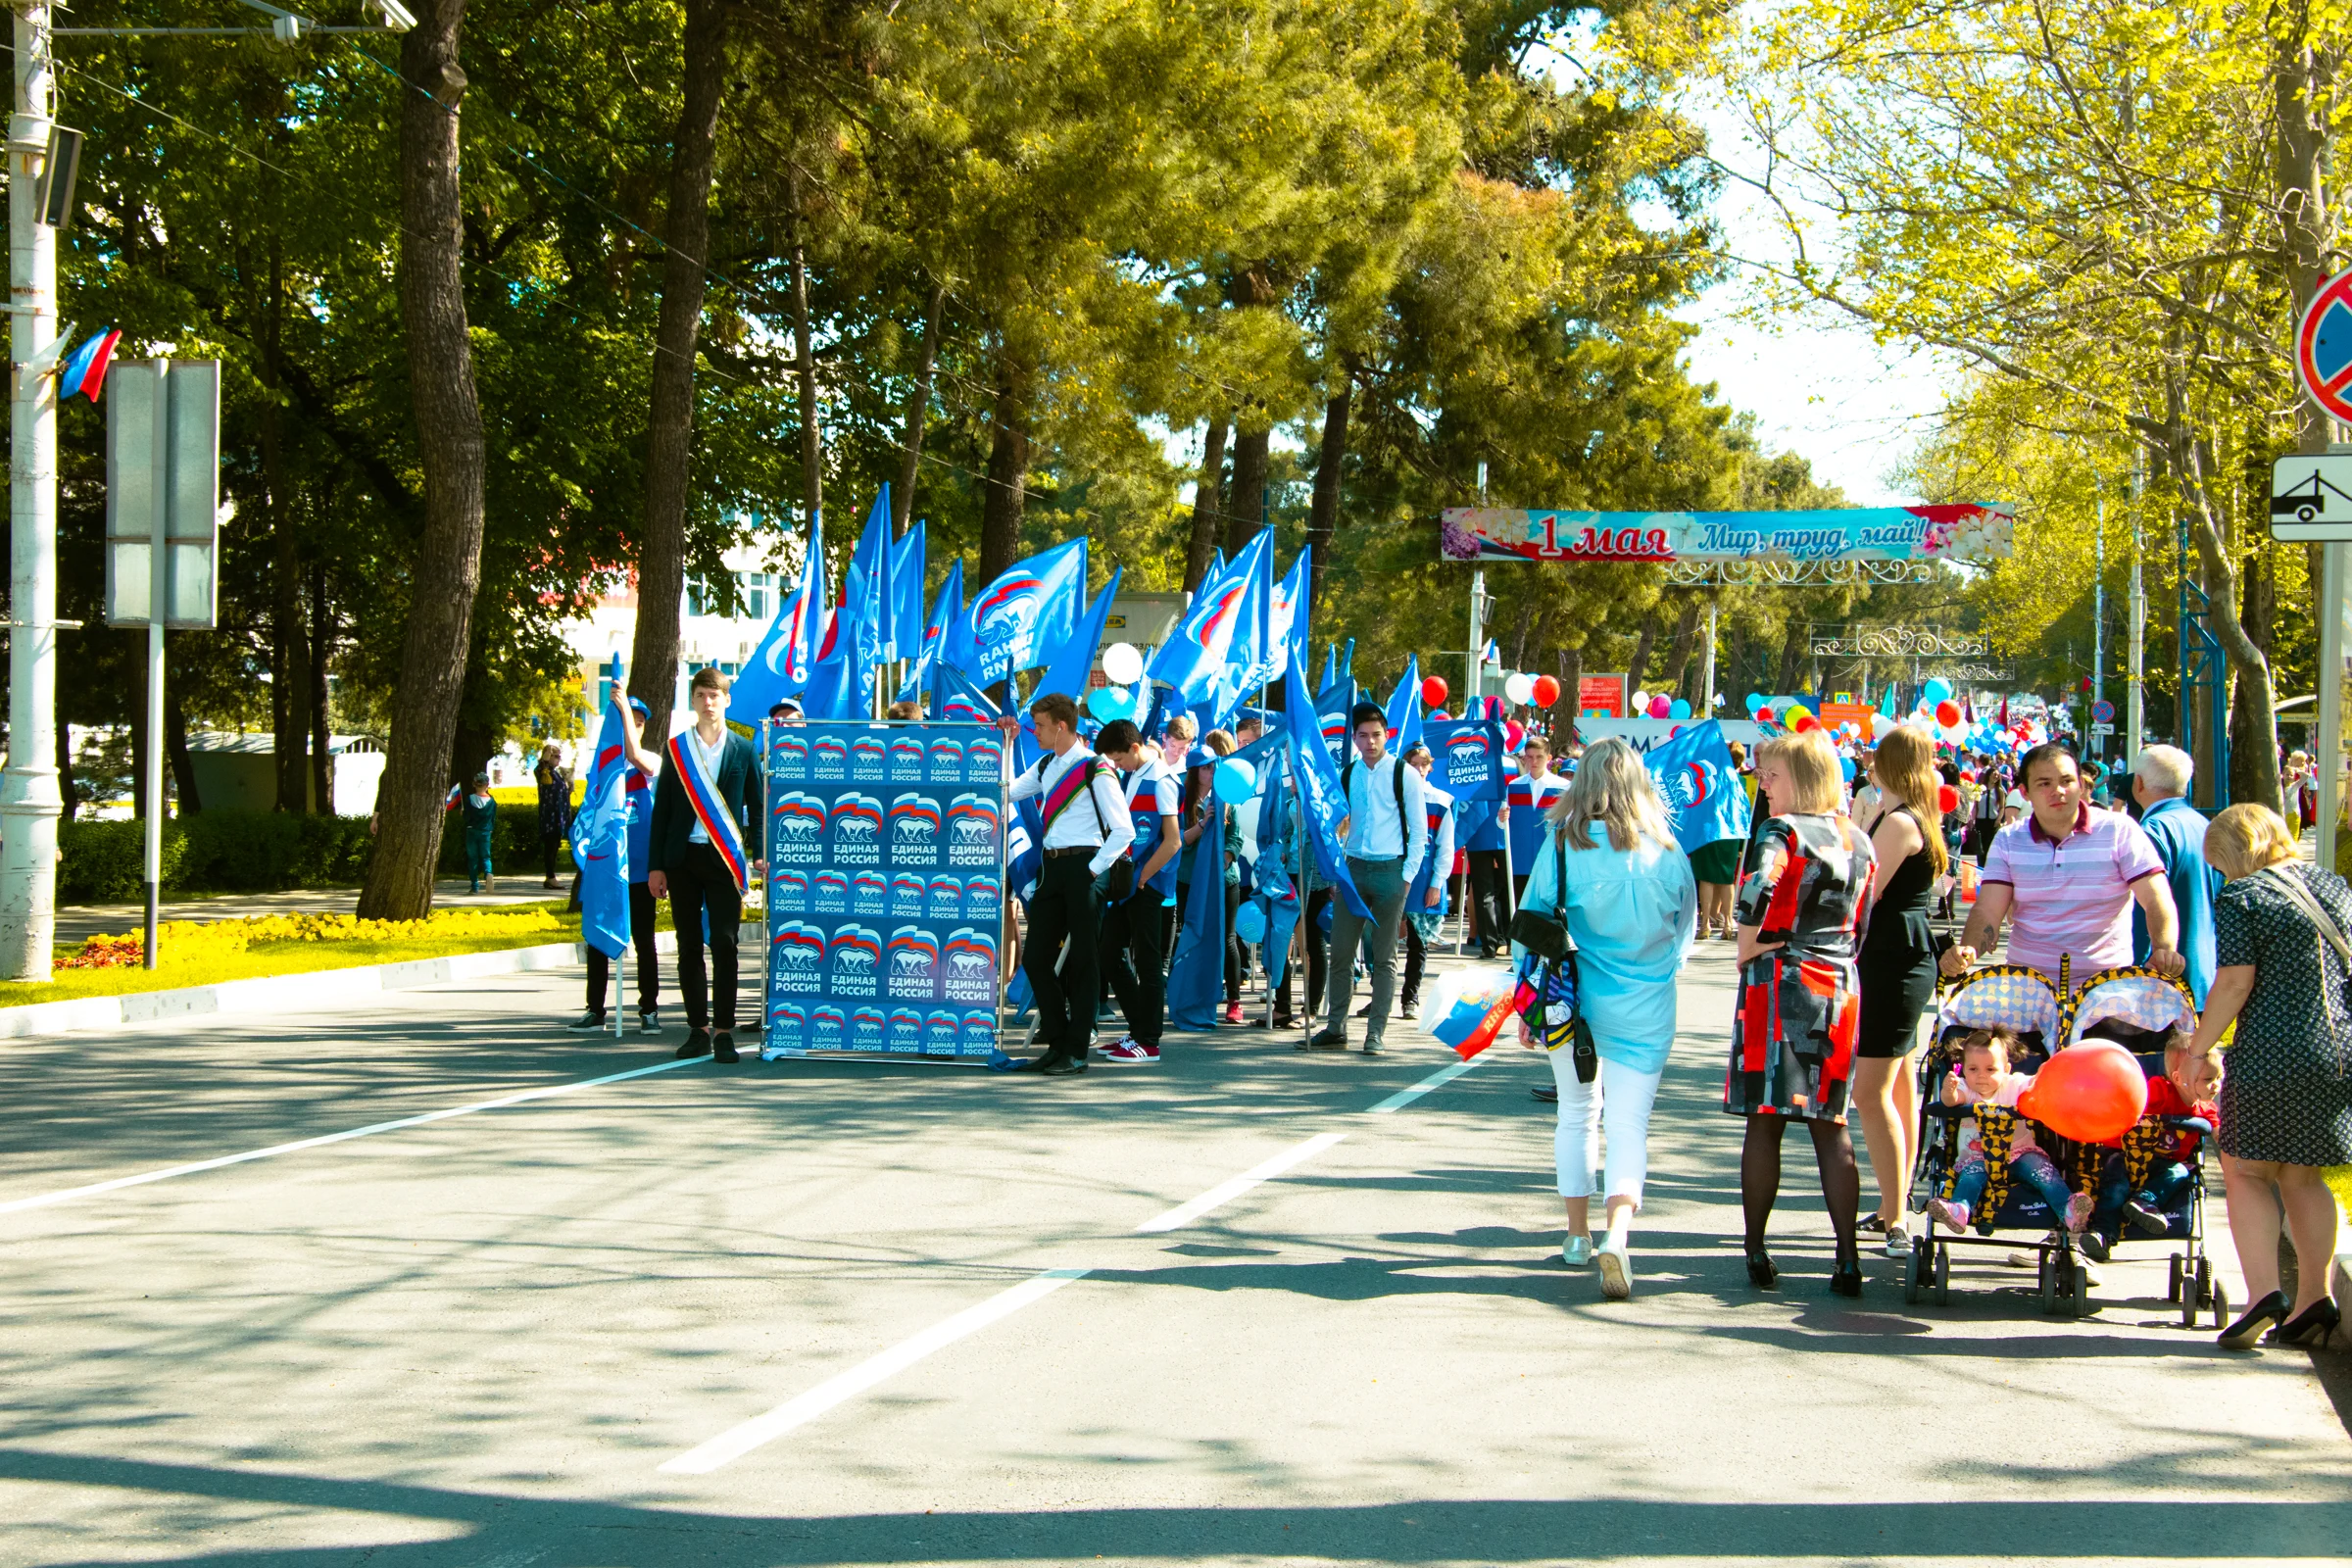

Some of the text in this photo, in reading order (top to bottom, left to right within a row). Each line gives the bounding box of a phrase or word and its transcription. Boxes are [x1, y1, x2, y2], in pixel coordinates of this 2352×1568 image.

[1540, 514, 1672, 555] 1 мая
[1698, 516, 1929, 558] Мир, труд, май!
[1448, 764, 1488, 776] ЕДИНАЯ
[1449, 773, 1489, 784] РОССИЯ
[776, 844, 821, 853] ЕДИНАЯ
[834, 845, 879, 854] ЕДИНАЯ
[892, 846, 937, 855] ЕДИНАЯ
[950, 846, 994, 855] ЕДИНАЯ
[834, 855, 879, 863] РОССИЯ
[776, 972, 820, 982] ЕДИНАЯ
[832, 976, 876, 985] ЕДИНАЯ
[776, 983, 820, 992] РОССИЯ
[889, 978, 933, 988] ЕДИНАЯ
[946, 981, 990, 990] ЕДИНАЯ
[832, 986, 876, 995] РОССИЯ
[889, 989, 933, 998] РОССИЯ
[946, 991, 990, 1000] РОССИЯ
